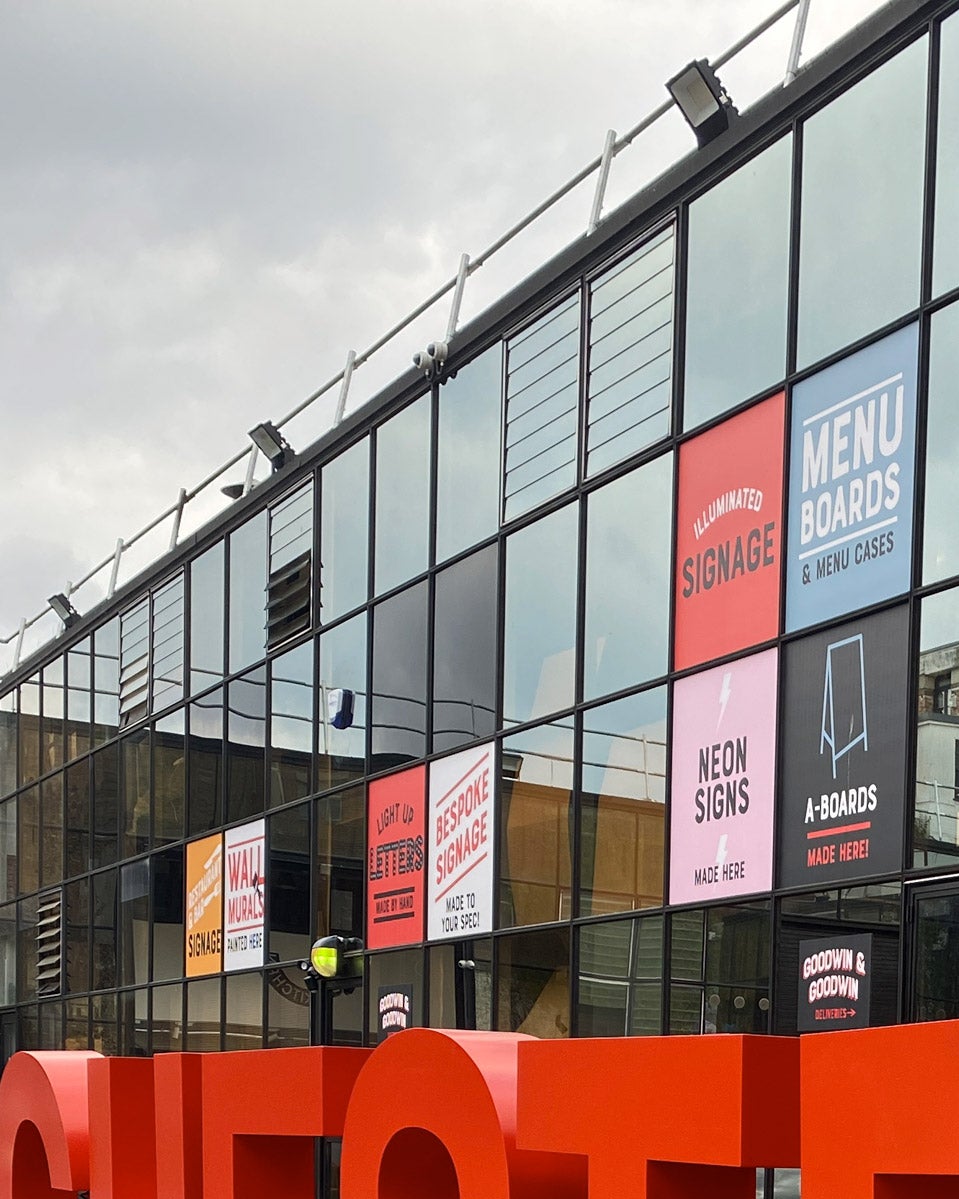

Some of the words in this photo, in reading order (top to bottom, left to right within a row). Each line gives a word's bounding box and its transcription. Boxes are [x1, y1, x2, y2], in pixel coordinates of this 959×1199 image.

[802, 385, 904, 493] MENU
[693, 487, 763, 540] ILLUMINATED
[800, 462, 900, 545] BOARDS
[682, 521, 776, 599] SIGNAGE
[802, 563, 811, 585] &
[816, 547, 850, 580] MENU
[854, 530, 894, 565] CASES
[698, 736, 747, 783] NEON
[436, 768, 489, 846] BESPOKE
[694, 777, 750, 824] SIGNS
[804, 784, 878, 823] A-BOARDS
[377, 803, 400, 835] LIGHT
[402, 803, 414, 825] UP
[369, 834, 424, 881] LETTERS
[436, 810, 488, 885] SIGNAGE
[807, 844, 835, 867] MADE
[839, 838, 869, 863] HERE!
[228, 845, 265, 892] WALL
[694, 865, 719, 886] MADE
[722, 861, 745, 881] HERE
[228, 891, 265, 925] MURALS
[376, 898, 390, 914] MADE
[391, 897, 398, 912] BY
[399, 895, 413, 910] HAND
[446, 894, 464, 913] MADE
[466, 893, 476, 909] TO
[441, 916, 459, 933] YOUR
[460, 912, 480, 930] SPEC!
[188, 928, 221, 958] SIGNAGE
[227, 935, 247, 953] PAINTED
[249, 932, 262, 950] HERE
[802, 948, 853, 979] GOODWIN
[856, 952, 866, 976] &
[379, 992, 404, 1013] GOODWIN
[808, 975, 859, 1004] GOODWIN
[382, 1010, 407, 1029] GOODWIN
[815, 1007, 847, 1020] DELIVERIES
